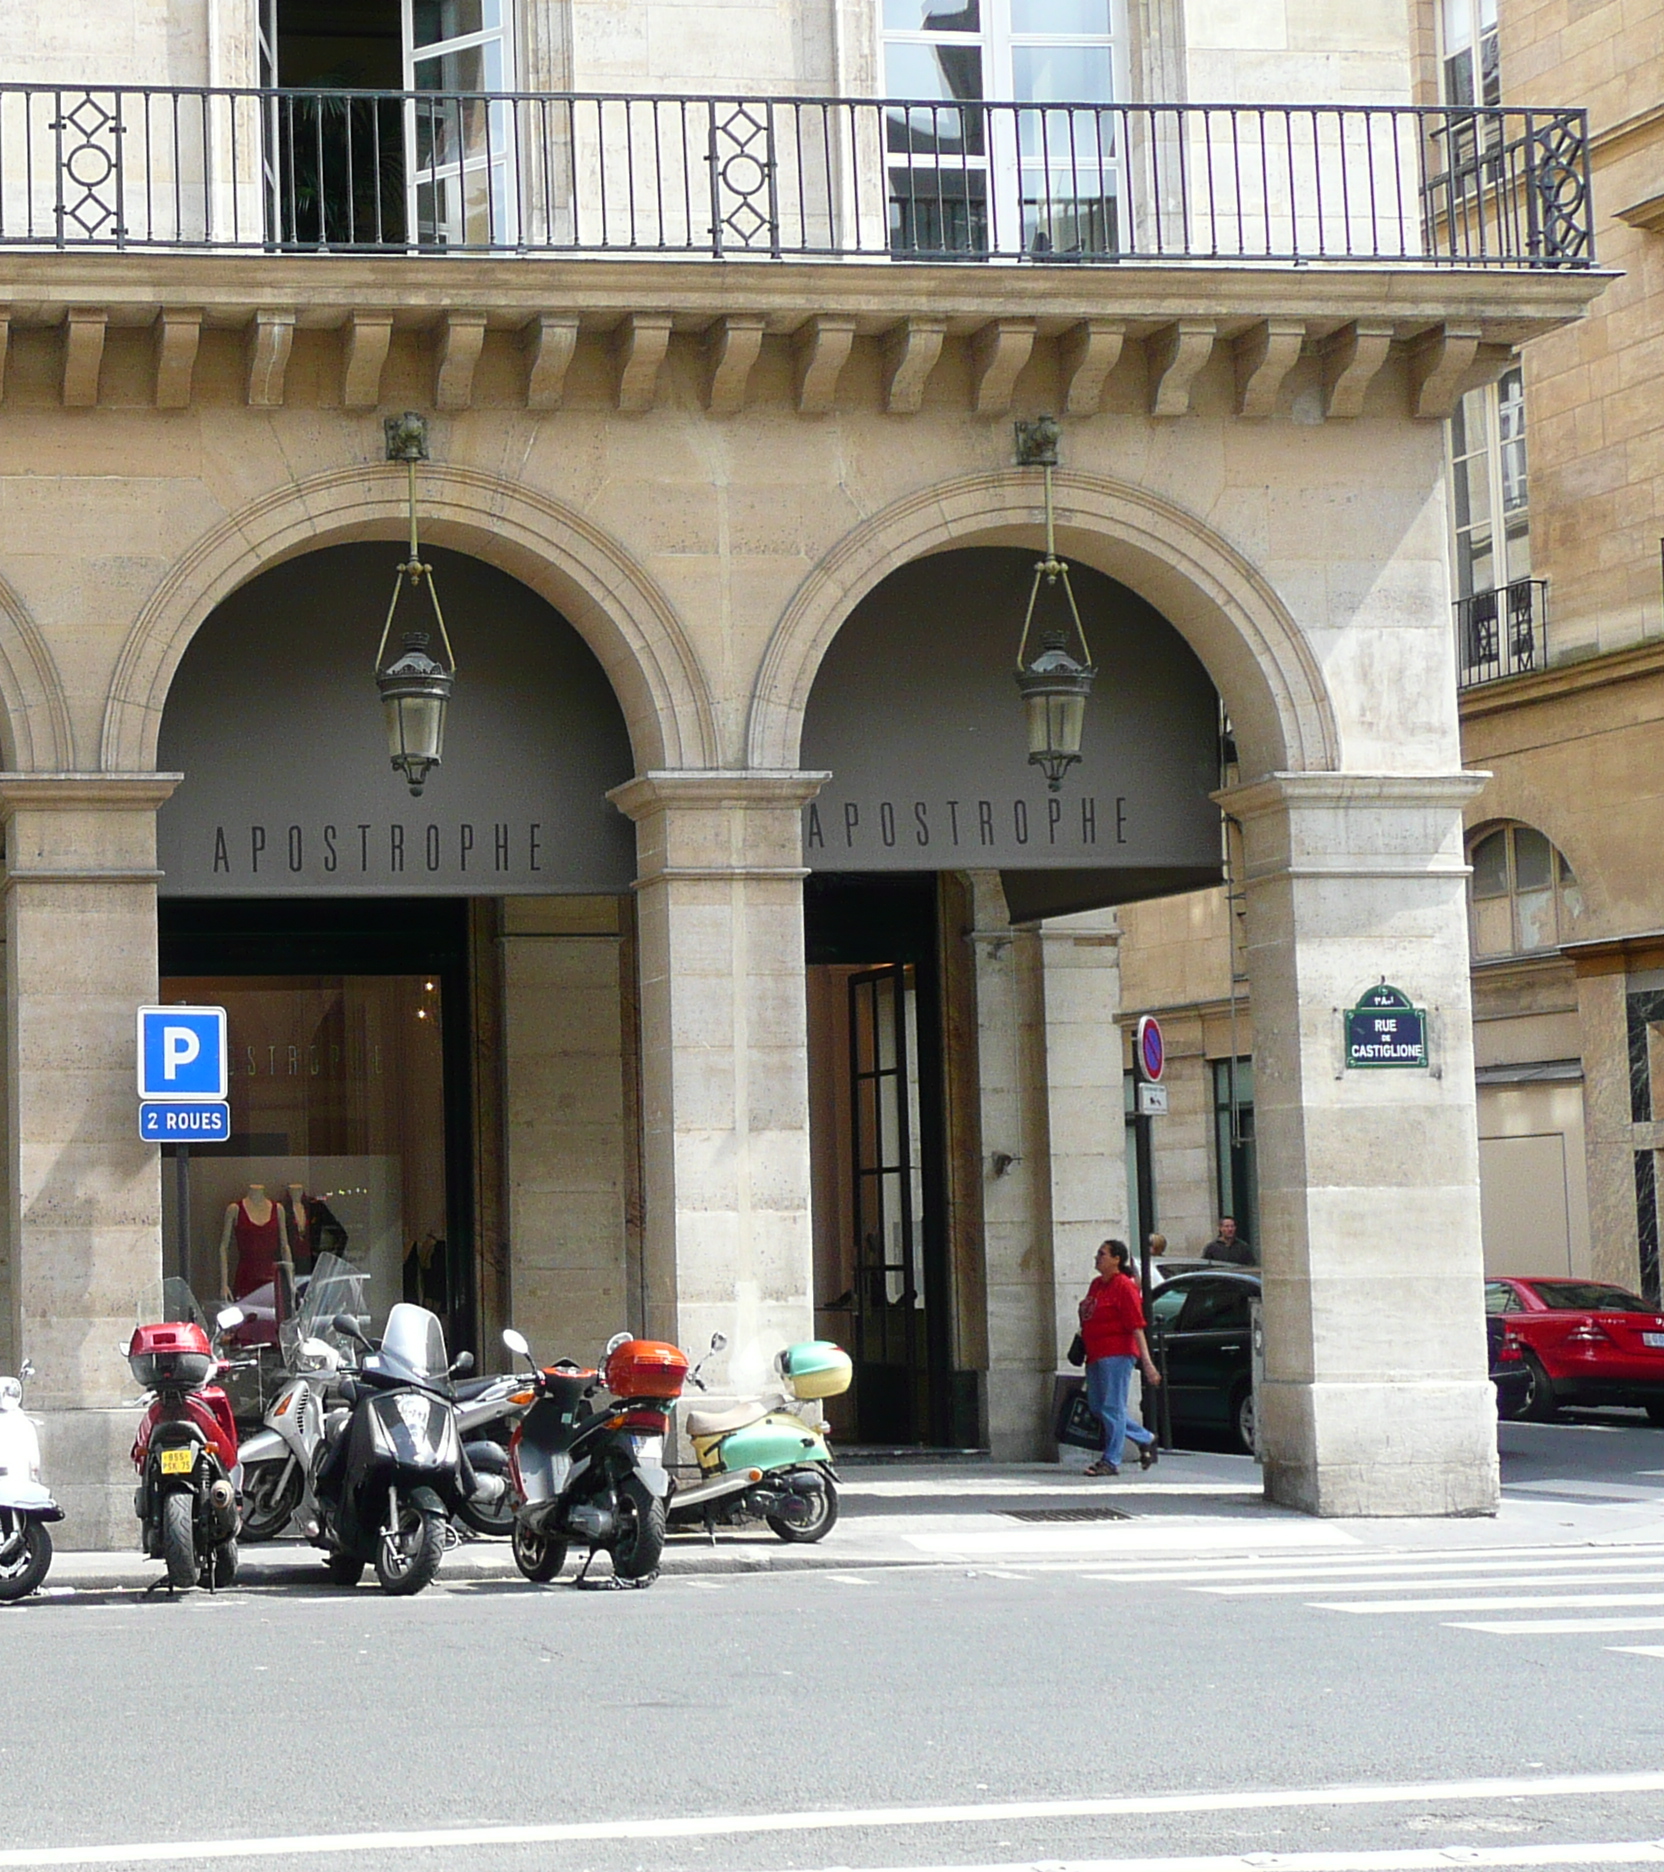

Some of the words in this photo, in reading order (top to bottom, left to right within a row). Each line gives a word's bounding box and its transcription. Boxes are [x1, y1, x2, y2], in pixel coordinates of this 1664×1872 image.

[808, 797, 1128, 848] APOSTROPHE
[213, 823, 542, 873] APOSTROPHE
[1374, 1019, 1398, 1032] RUE
[1381, 1034, 1391, 1042] DE
[163, 1026, 201, 1080] P
[1351, 1044, 1423, 1057] CASTIGLIONE
[147, 1112, 159, 1130] 2
[166, 1112, 222, 1130] ROUES
